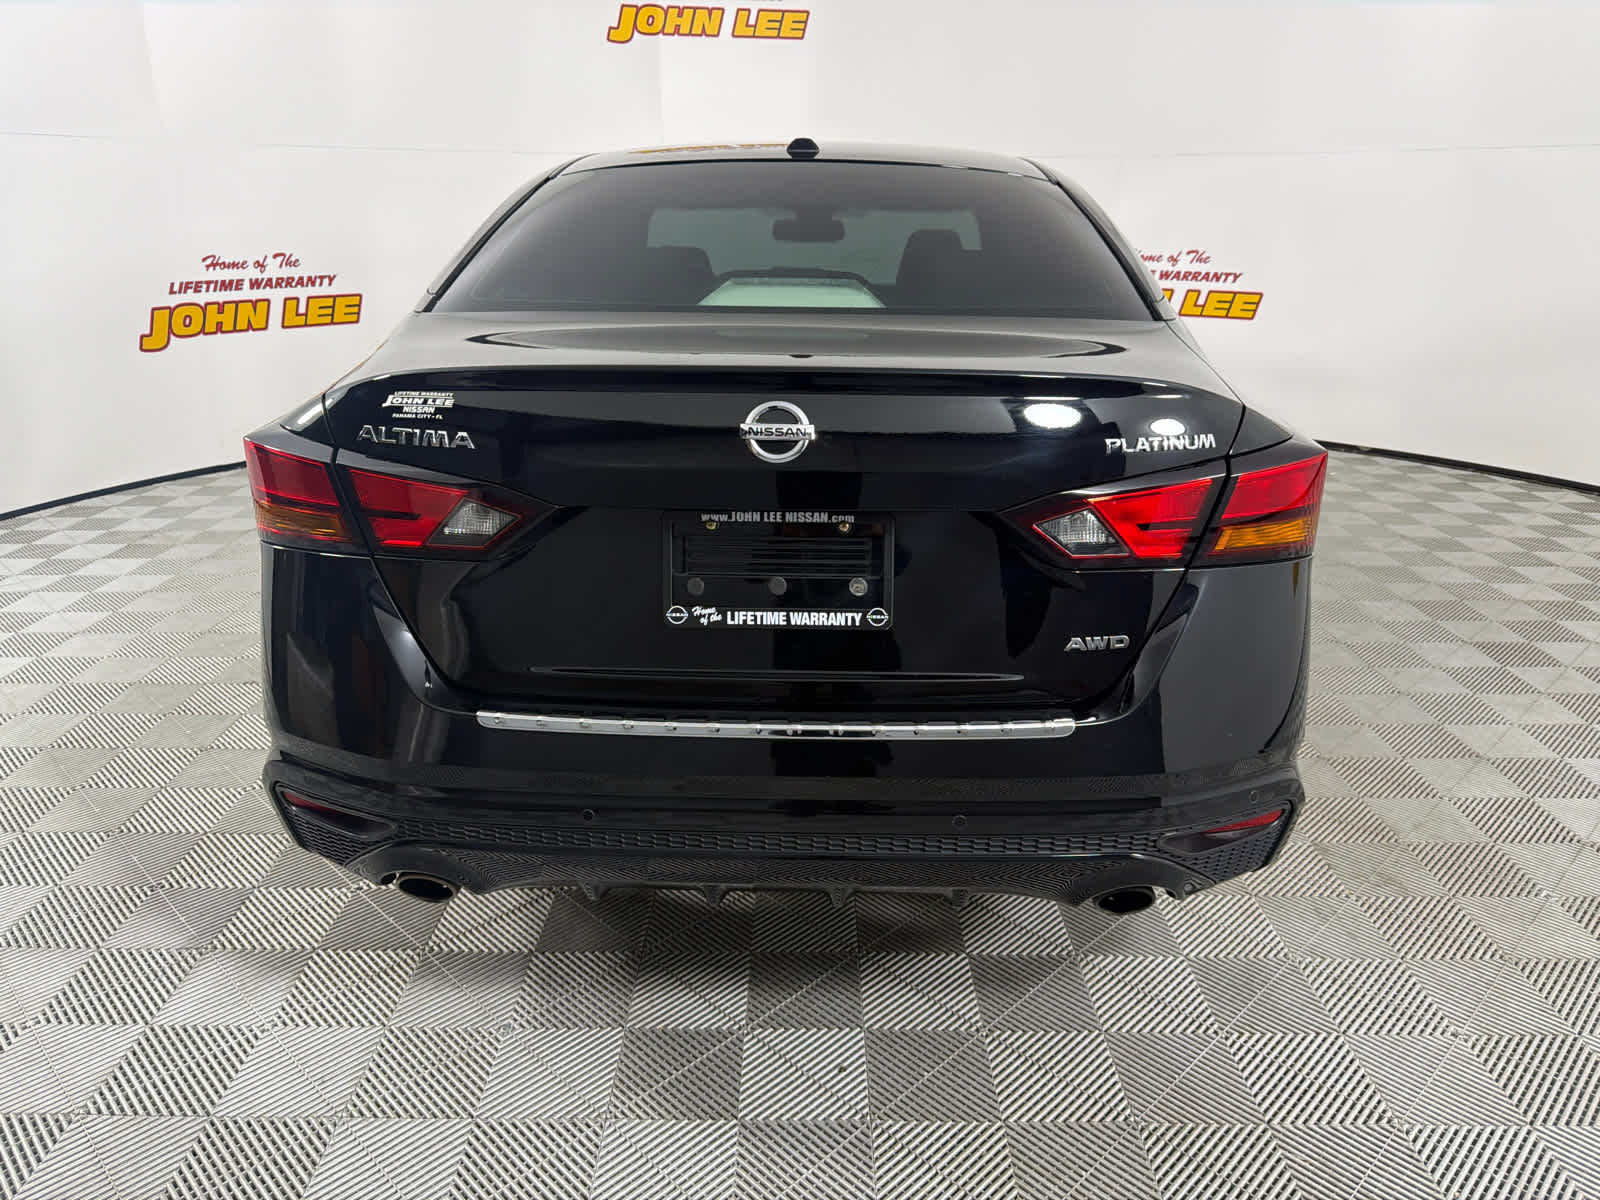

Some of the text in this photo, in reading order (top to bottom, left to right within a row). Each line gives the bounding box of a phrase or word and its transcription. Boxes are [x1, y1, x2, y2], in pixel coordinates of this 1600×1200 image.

[607, 4, 809, 44] JOHN LEE
[202, 252, 301, 273] Home of The
[1136, 249, 1211, 266] ome of The
[168, 274, 337, 295] LIFETIME WARRANTY
[1159, 270, 1242, 283] WARRANTY
[1178, 289, 1263, 320] LEE
[139, 293, 362, 352] JOHN LEE
[382, 395, 455, 407] JOHN LEE
[358, 425, 476, 449] ALTIMA
[748, 427, 807, 437] NISSAN
[1105, 434, 1216, 454] PLATINUM
[764, 511, 782, 523] LEE
[692, 606, 716, 616] Home
[700, 612, 722, 626] of the
[727, 611, 862, 626] LIFETIME WARRANTY
[1064, 635, 1130, 651] AWD
